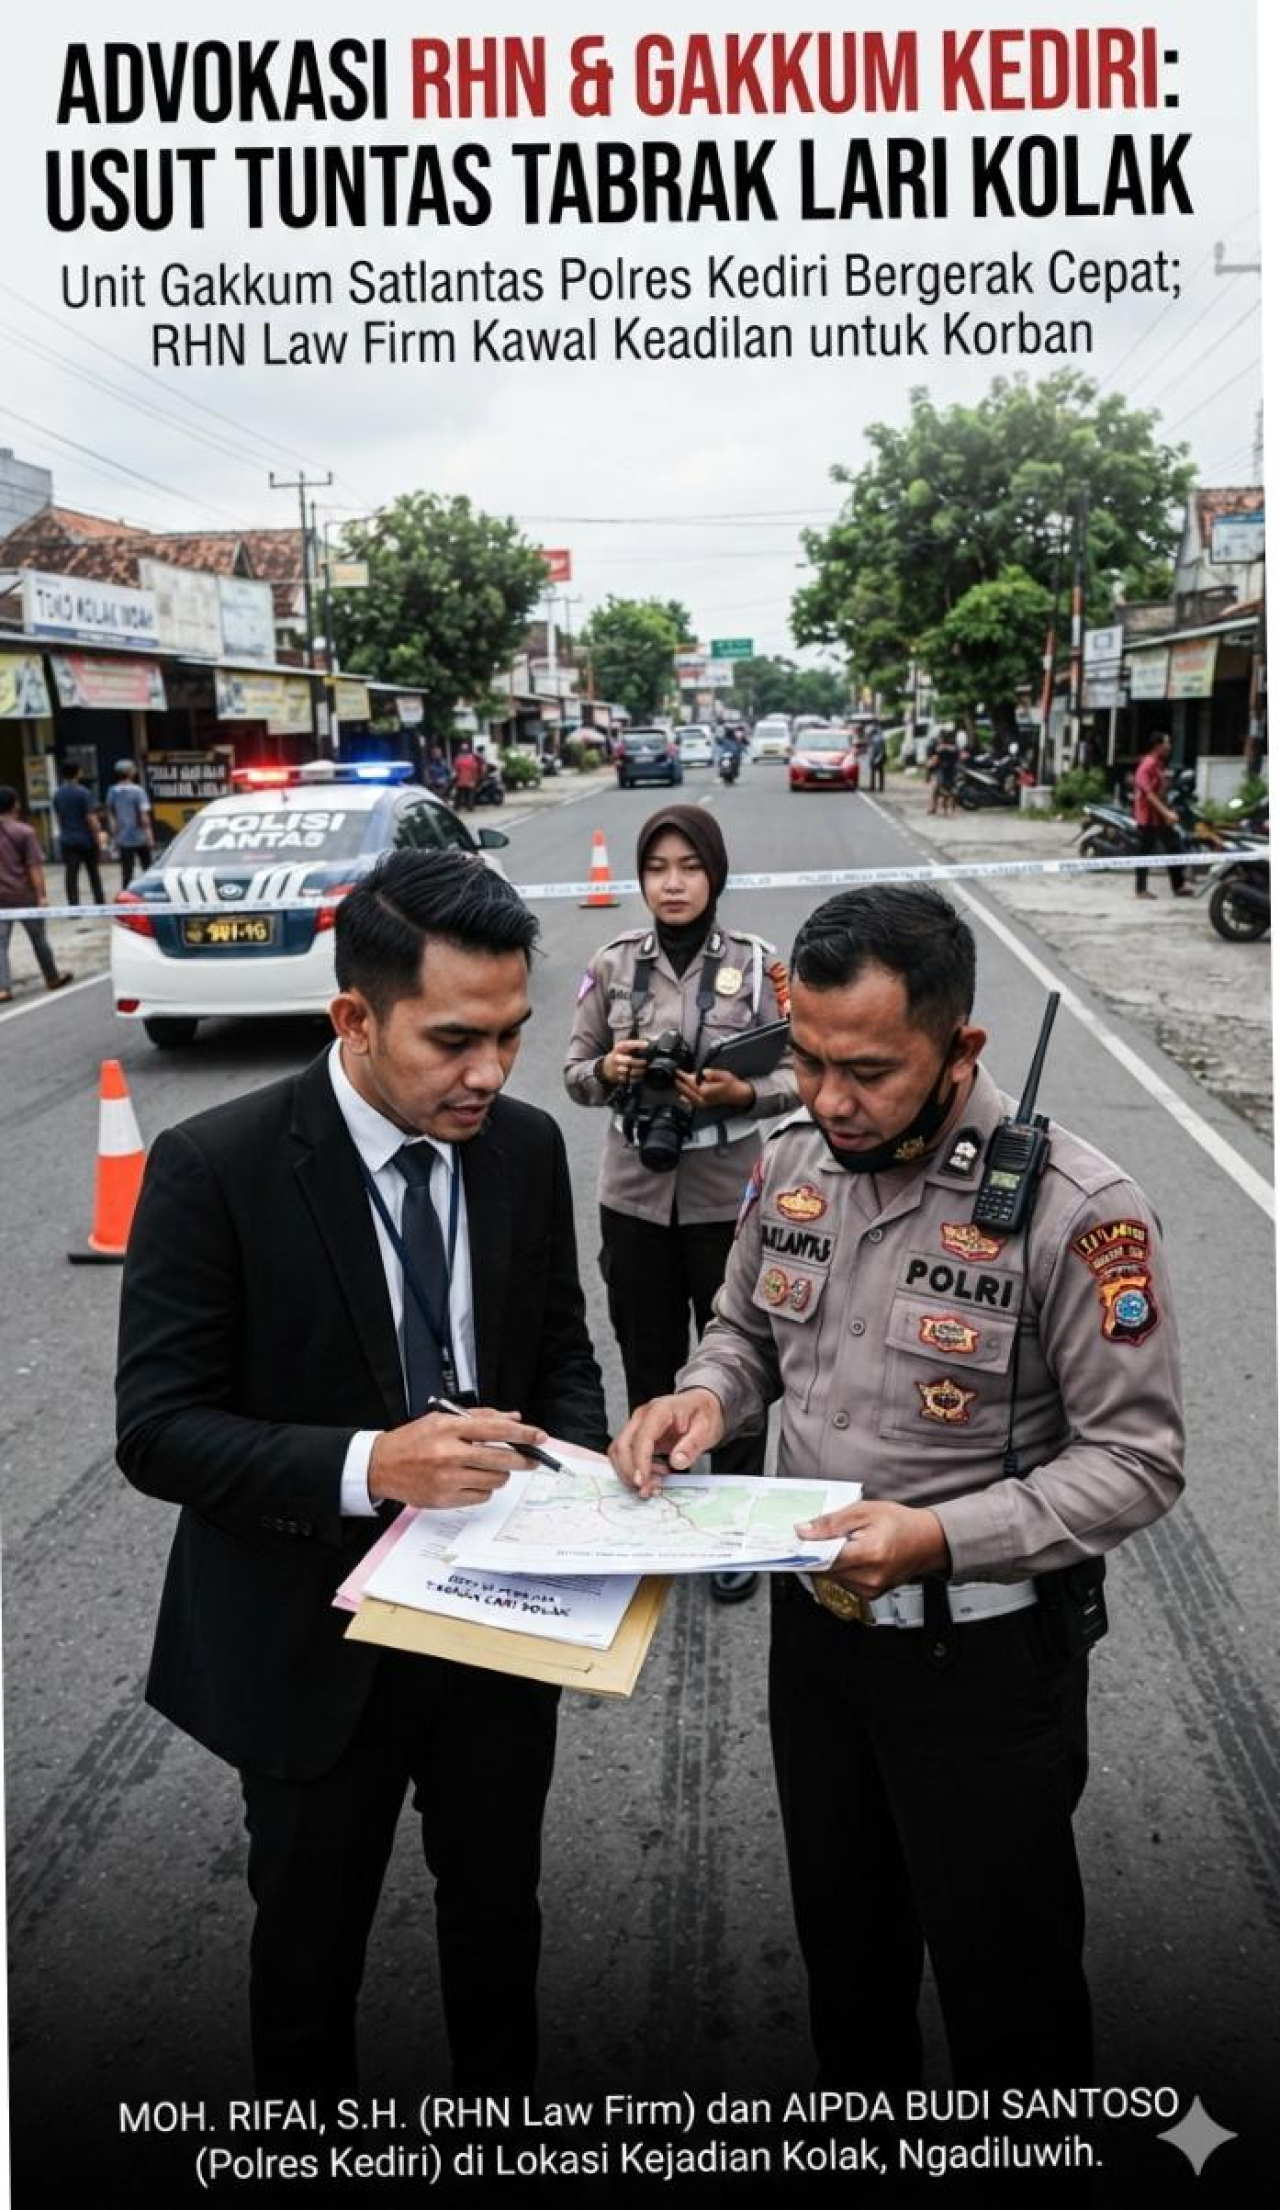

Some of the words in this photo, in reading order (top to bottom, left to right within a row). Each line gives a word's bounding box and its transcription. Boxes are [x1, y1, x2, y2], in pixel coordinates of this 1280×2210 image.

[199, 812, 345, 834] POLISI
[196, 831, 325, 850] LANTAS
[905, 1258, 1013, 1308] POLRI
